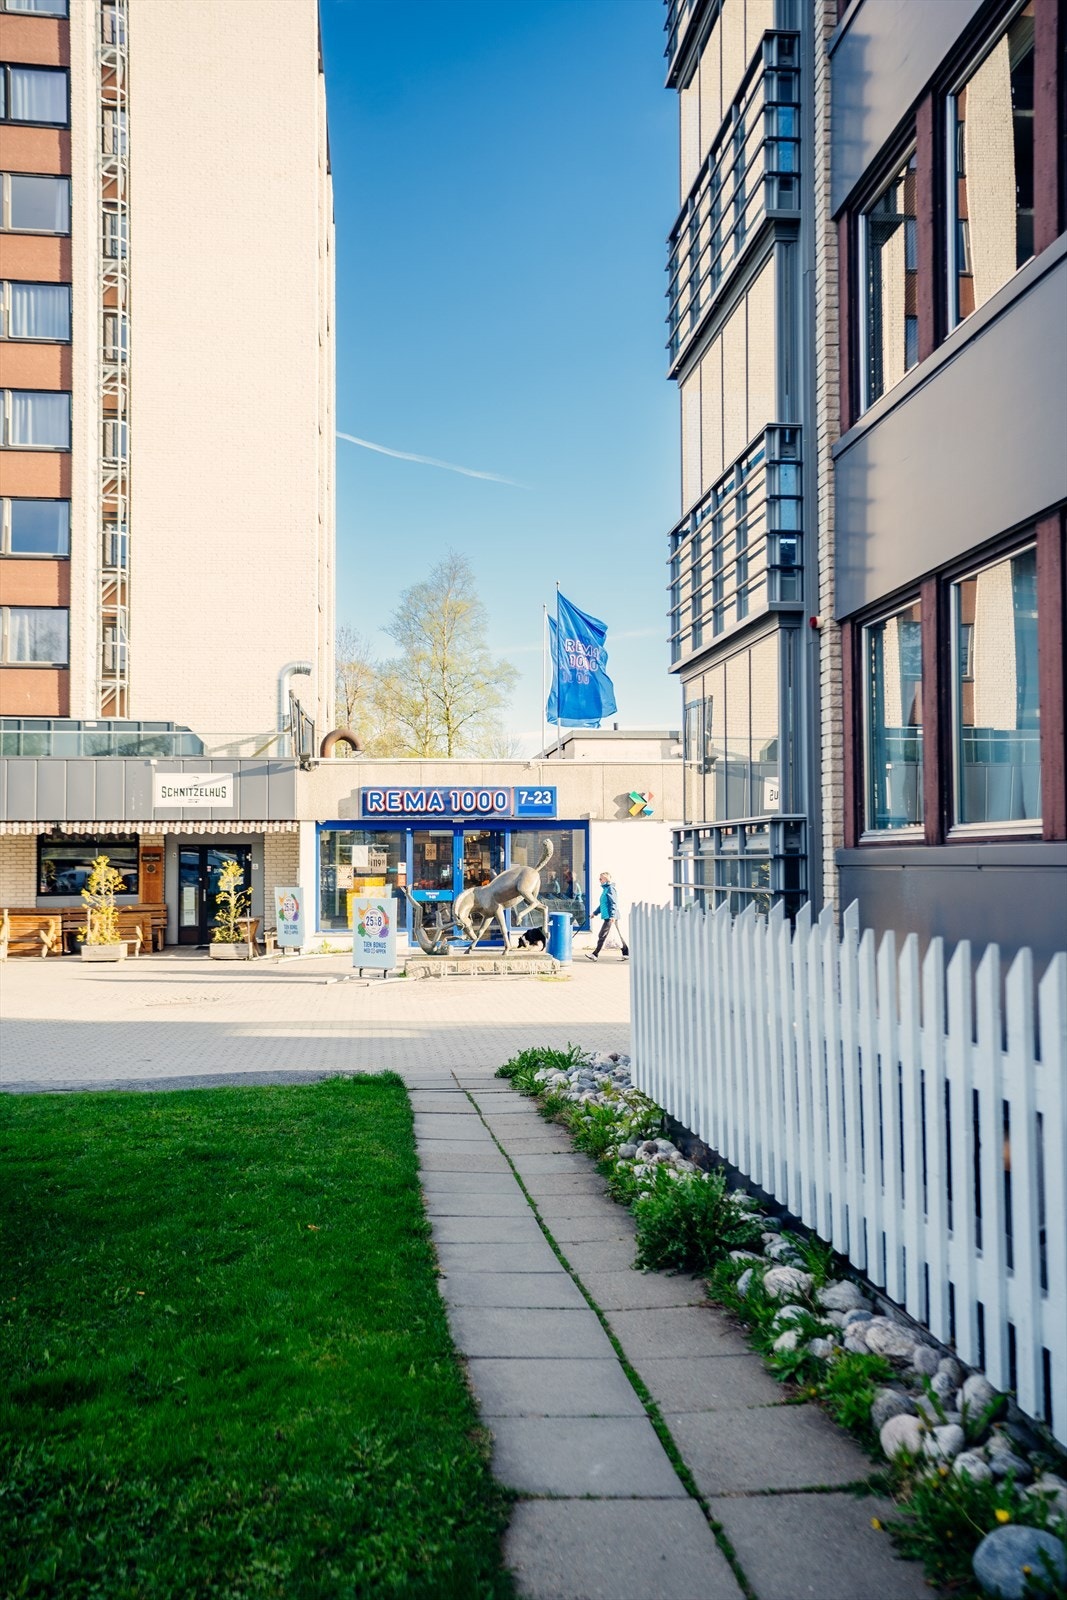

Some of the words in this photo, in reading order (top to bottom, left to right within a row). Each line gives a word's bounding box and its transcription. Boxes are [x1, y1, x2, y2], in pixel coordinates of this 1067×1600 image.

[161, 785, 227, 799] SCHNITZELHUS
[519, 791, 552, 805] 7-23
[367, 790, 445, 812] REMA
[450, 790, 508, 812] 1000
[365, 916, 374, 926] 25
[377, 916, 382, 926] 8
